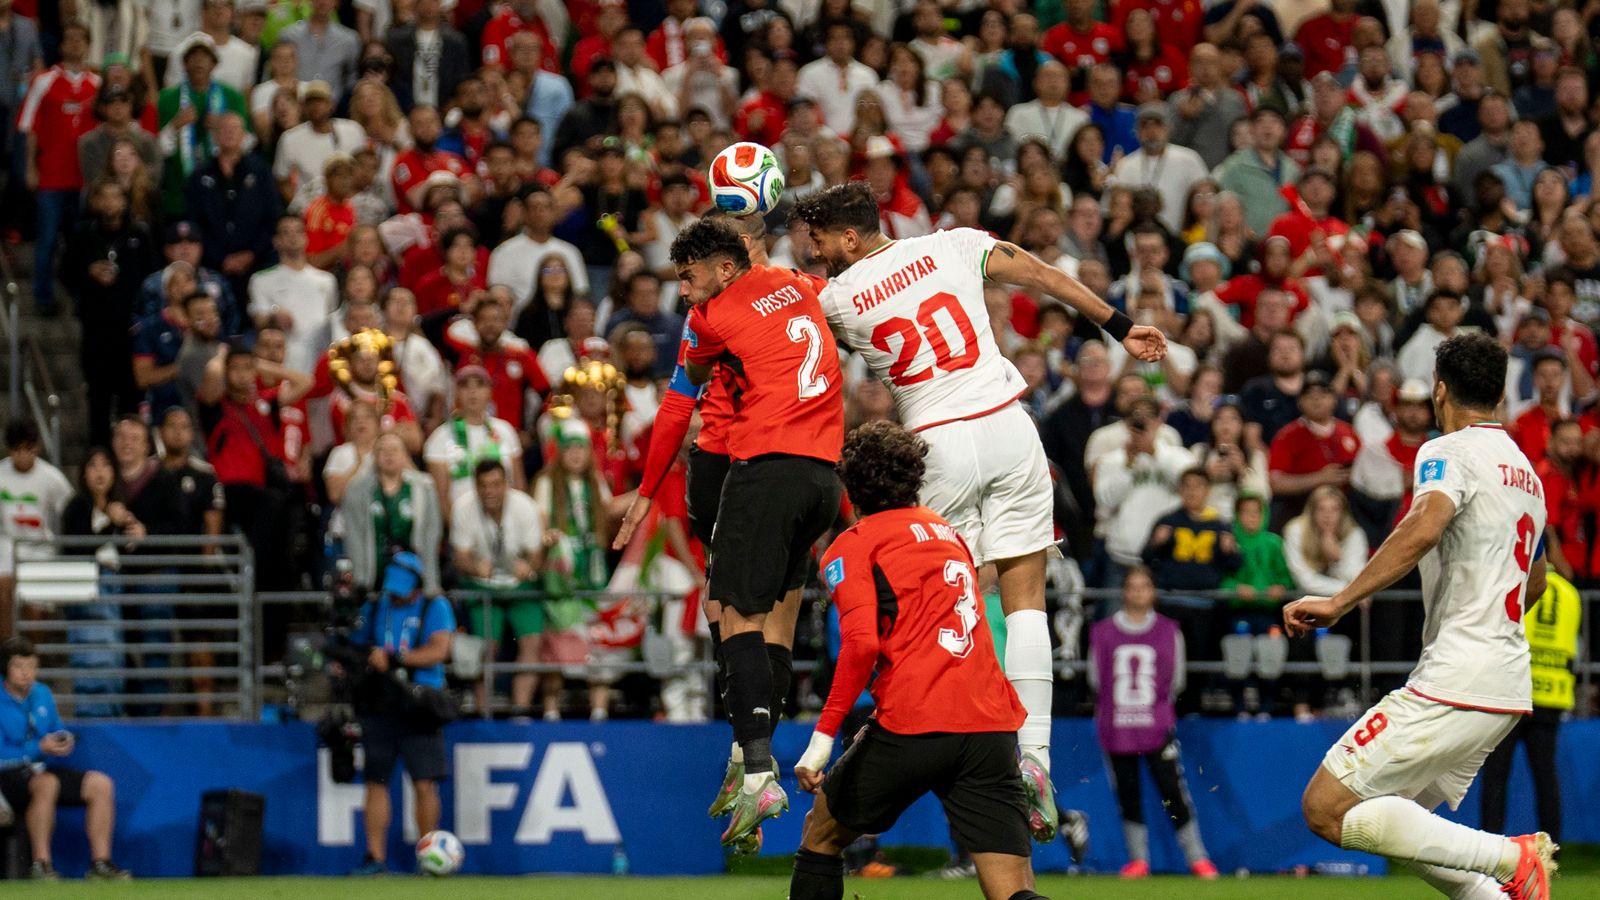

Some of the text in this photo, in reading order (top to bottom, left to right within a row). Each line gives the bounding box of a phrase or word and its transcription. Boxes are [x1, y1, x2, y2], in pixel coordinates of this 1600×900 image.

[751, 285, 803, 317] YASSER
[853, 255, 938, 316] SHAHRIYAR
[870, 291, 980, 387] 20
[786, 315, 829, 401] 2
[1498, 464, 1543, 500] TAREM
[910, 523, 934, 543] M.
[1173, 527, 1217, 564] M
[938, 560, 980, 659] 3
[1354, 712, 1388, 747] 9
